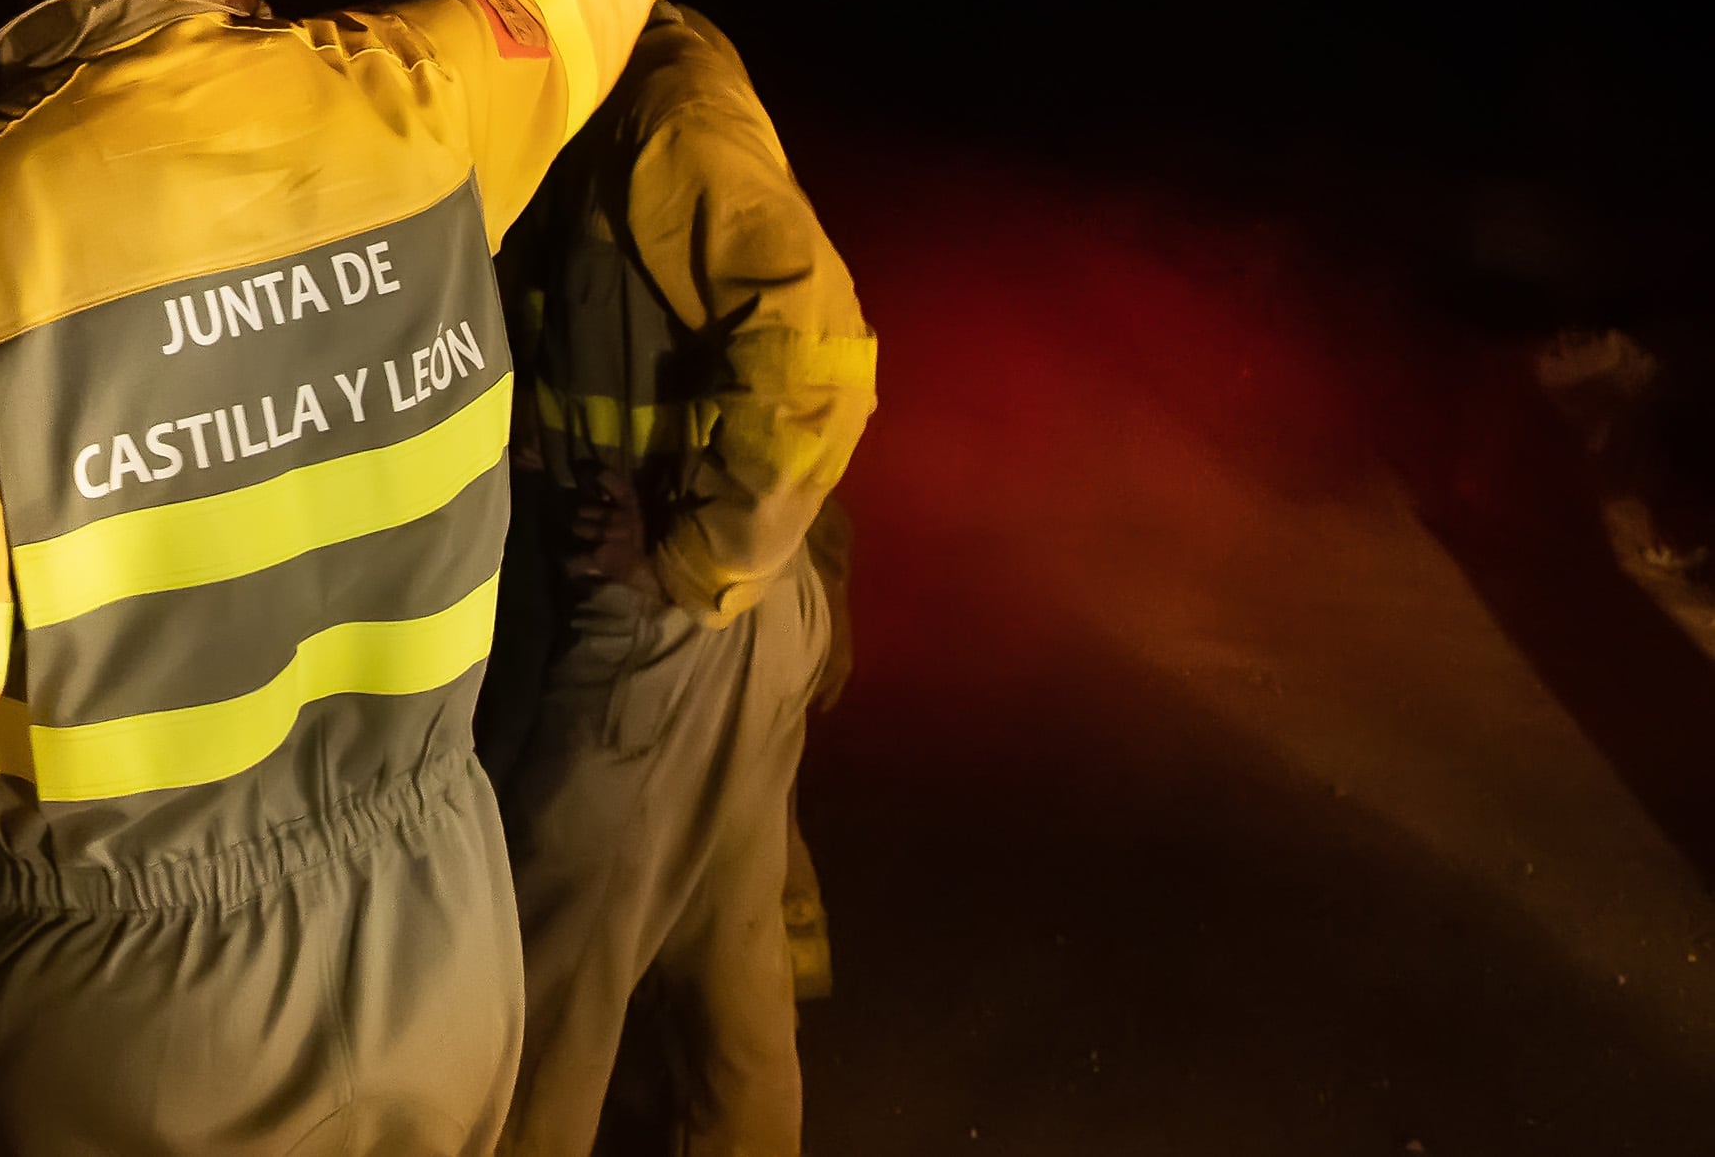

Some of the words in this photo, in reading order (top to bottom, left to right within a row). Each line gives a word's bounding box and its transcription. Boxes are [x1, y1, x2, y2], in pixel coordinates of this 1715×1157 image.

[162, 264, 330, 356] JUNTA
[330, 241, 401, 306] DE
[72, 384, 330, 500] CASTILLA
[334, 367, 369, 423] Y
[384, 320, 486, 413] LEÓN
